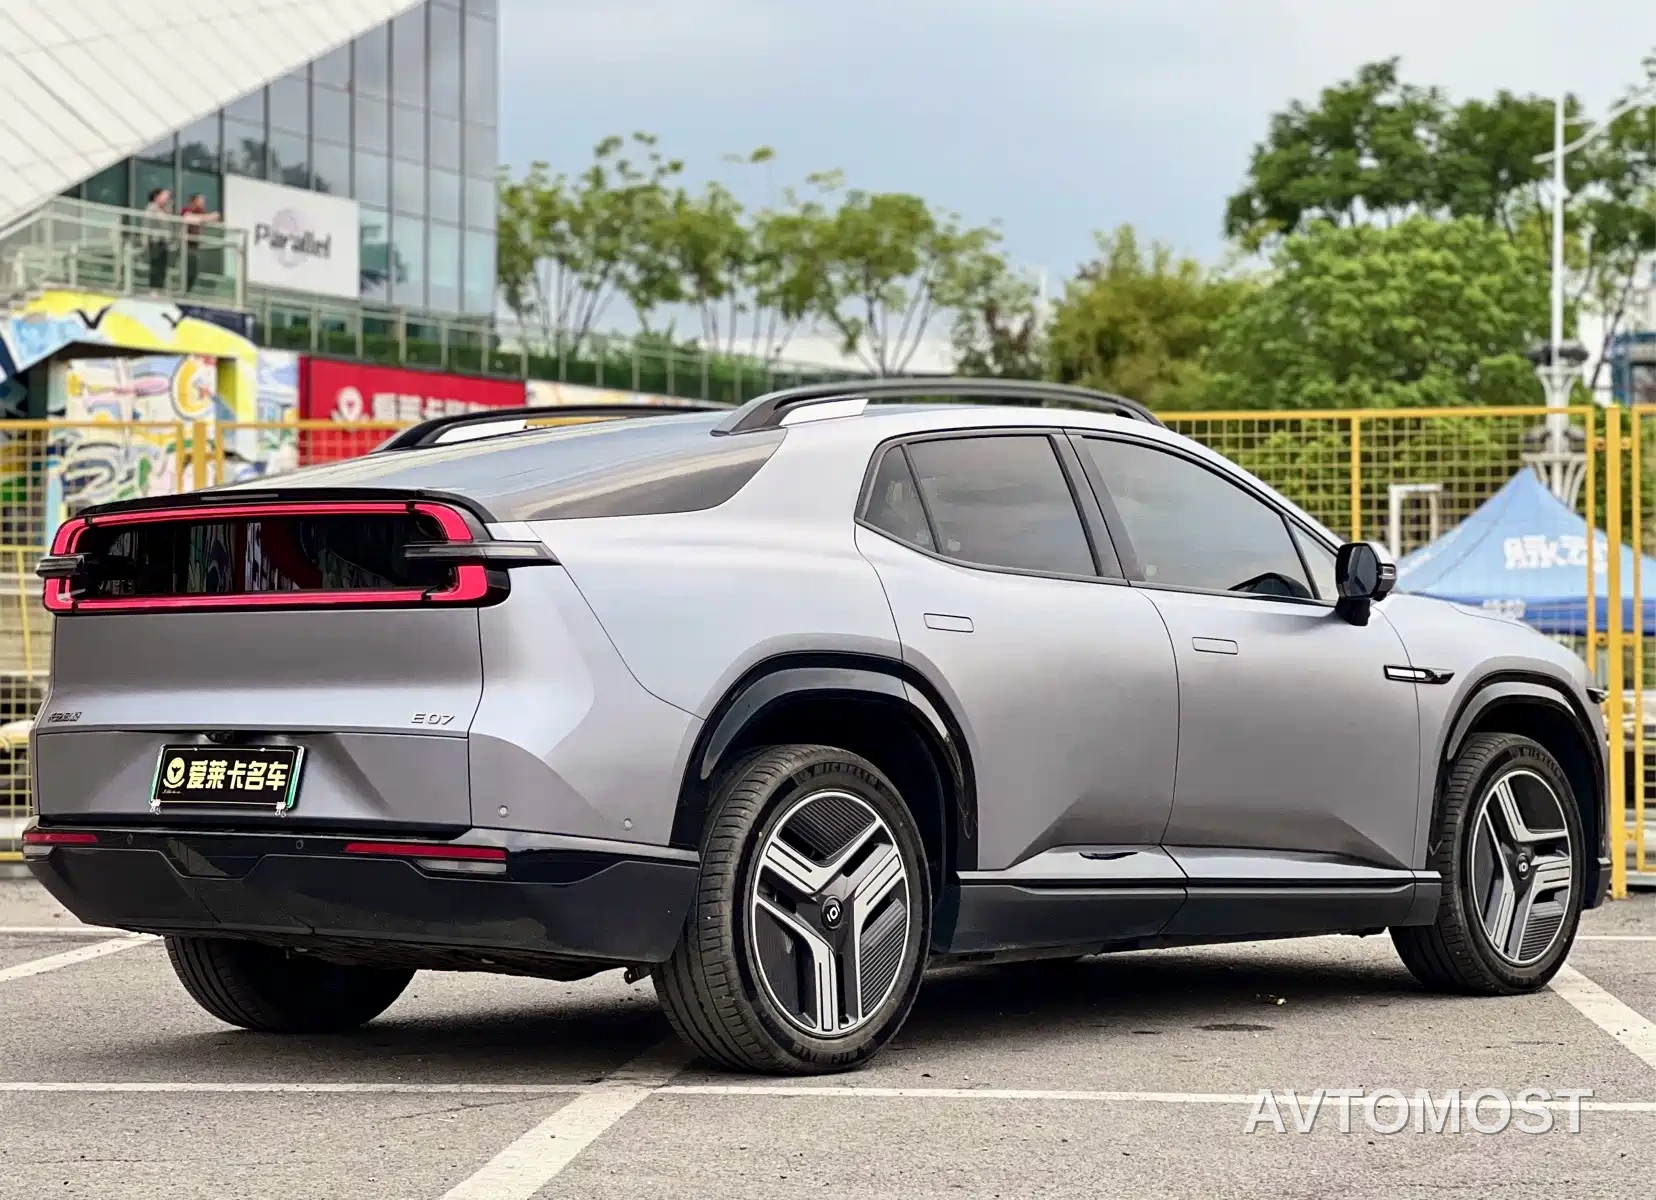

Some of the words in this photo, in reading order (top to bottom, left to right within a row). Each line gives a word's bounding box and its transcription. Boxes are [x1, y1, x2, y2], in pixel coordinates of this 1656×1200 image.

[254, 222, 332, 260] Parallel
[411, 712, 455, 725] E07
[186, 759, 289, 791] 爱莱卡名车
